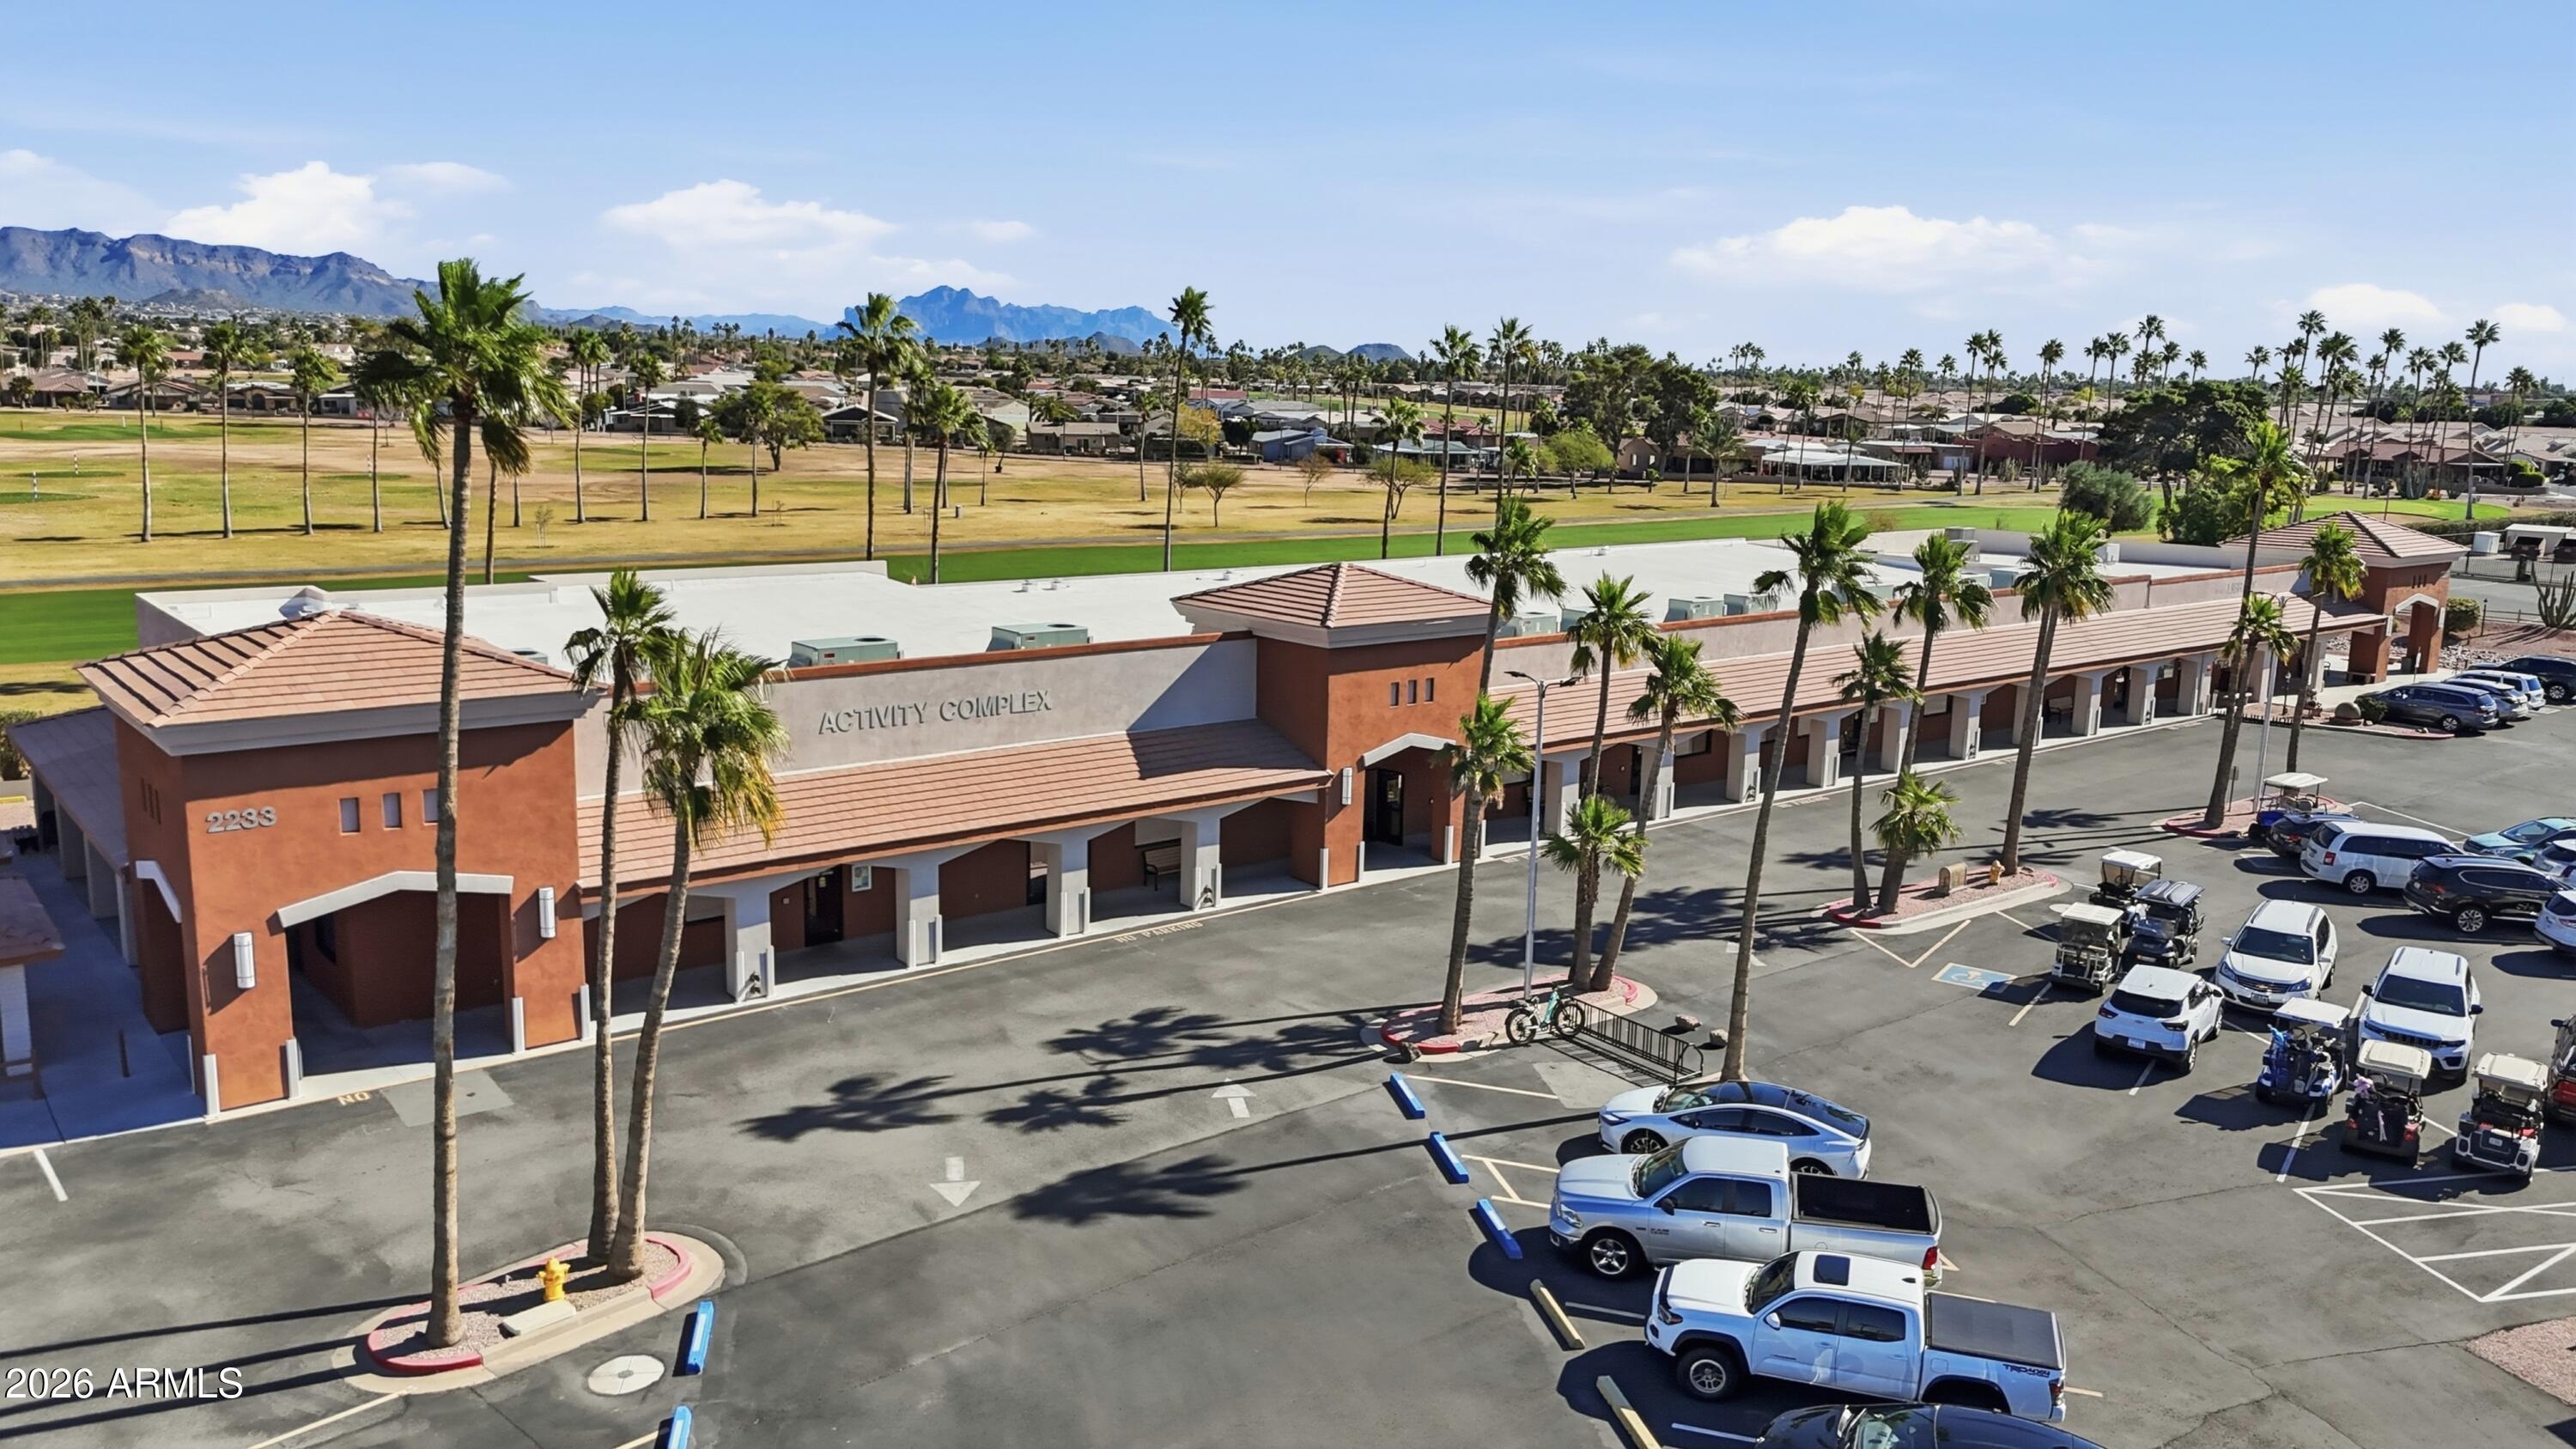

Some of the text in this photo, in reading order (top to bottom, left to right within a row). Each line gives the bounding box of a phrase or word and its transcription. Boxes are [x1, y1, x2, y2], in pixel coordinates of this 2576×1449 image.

[818, 690, 1052, 734] ACTIVITY COMPLEX
[205, 806, 276, 833] 2233
[337, 1092, 370, 1105] NO
